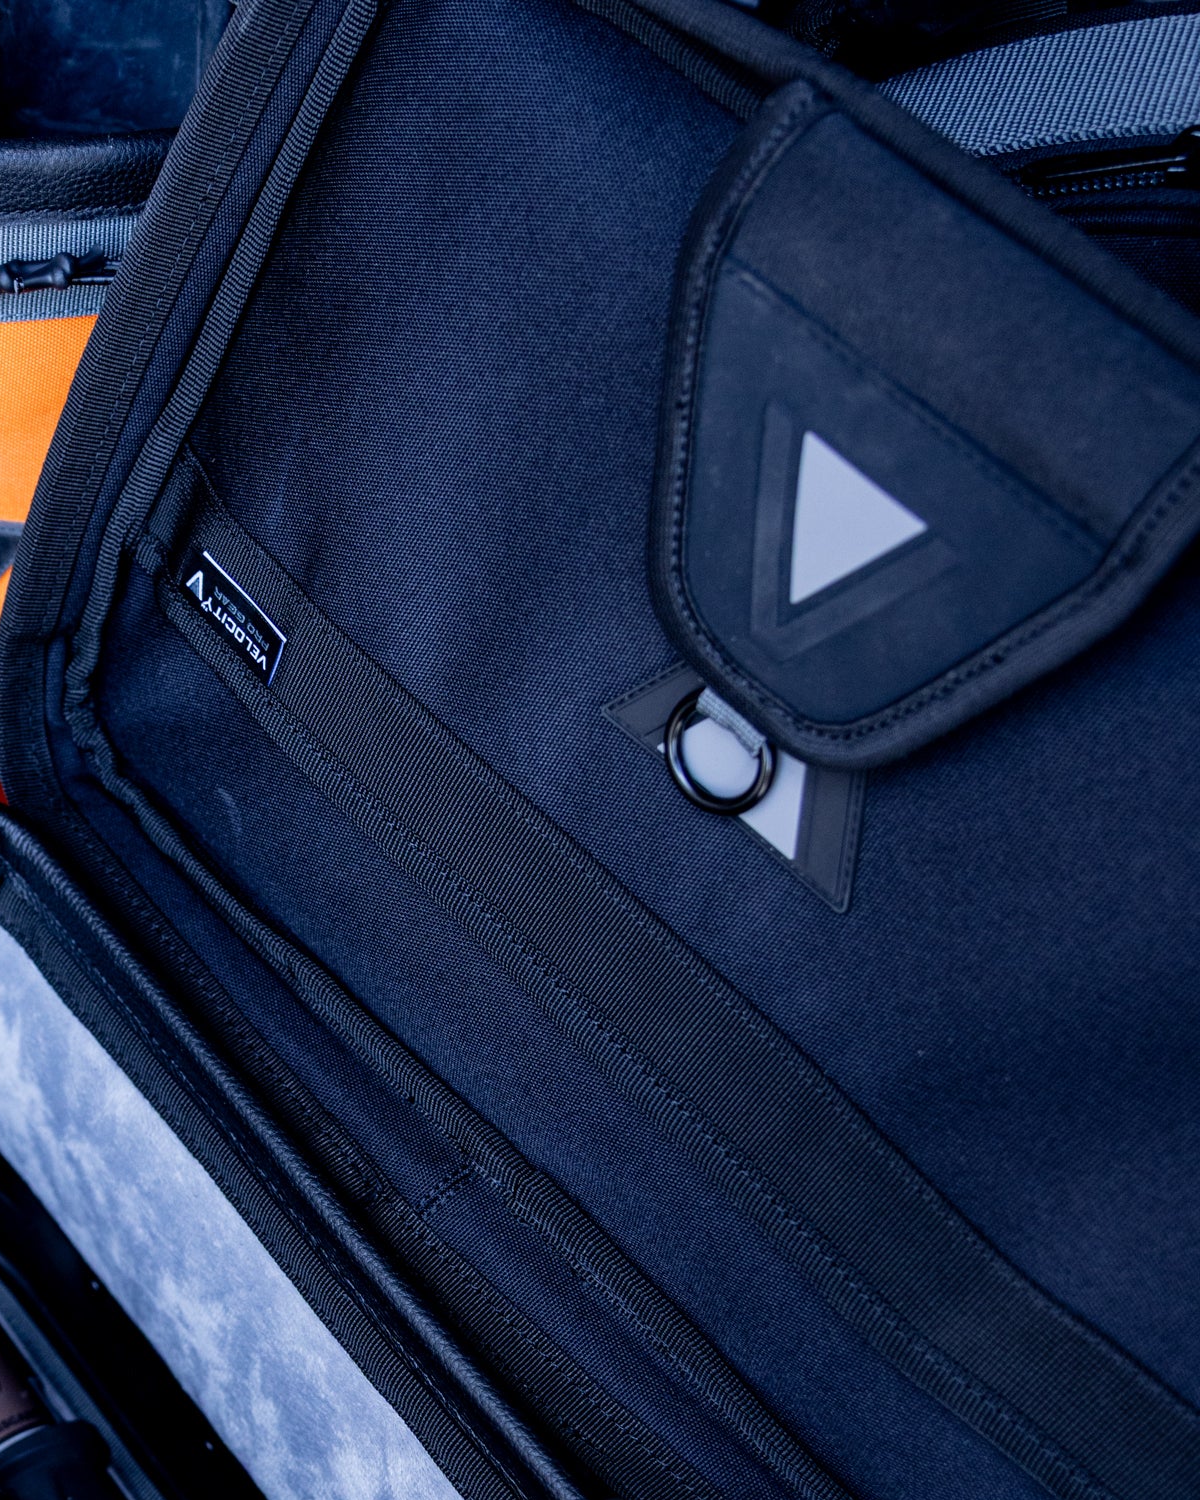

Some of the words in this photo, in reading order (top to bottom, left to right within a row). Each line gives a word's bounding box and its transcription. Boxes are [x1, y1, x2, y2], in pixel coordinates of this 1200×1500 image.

[214, 586, 245, 623] GEAR
[200, 596, 267, 670] VELOCITY
[246, 622, 270, 651] PRO
